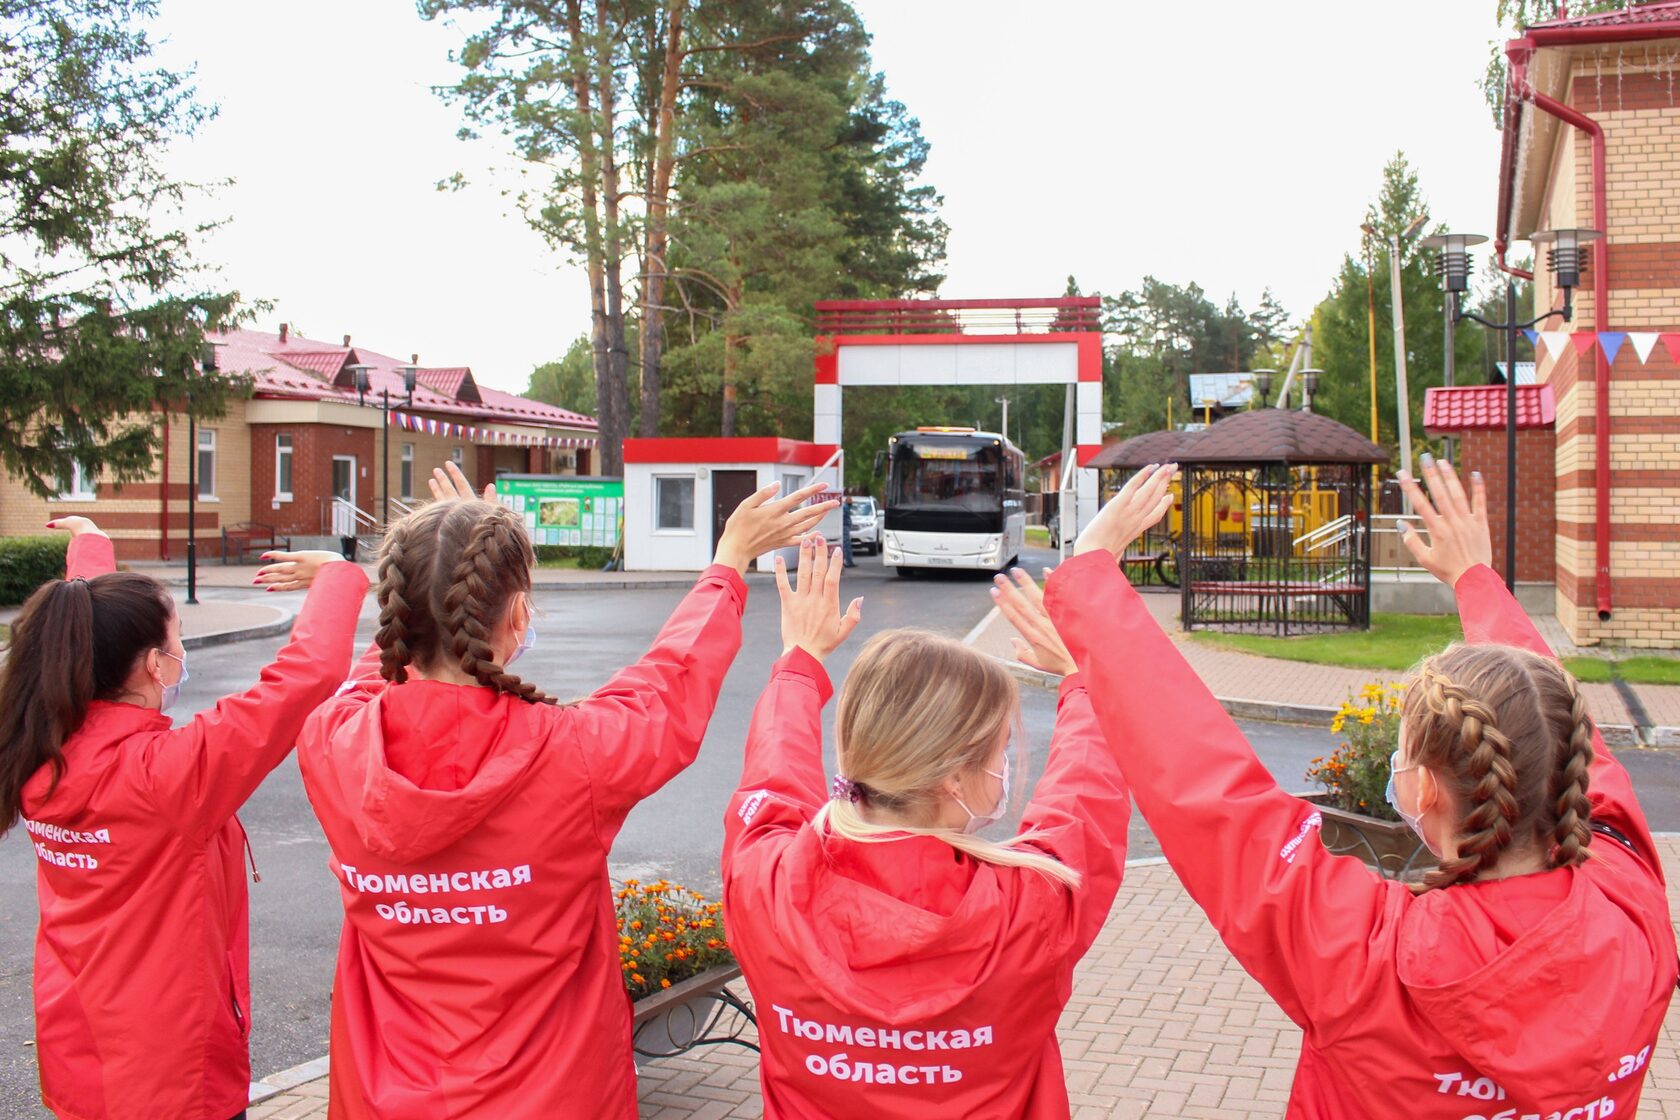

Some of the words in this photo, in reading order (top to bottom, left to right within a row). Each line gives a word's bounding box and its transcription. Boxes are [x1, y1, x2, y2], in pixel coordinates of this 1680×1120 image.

[340, 863, 531, 894] Тюменская
[375, 901, 508, 925] область
[772, 1004, 993, 1050] Тюменская
[805, 1053, 964, 1085] область
